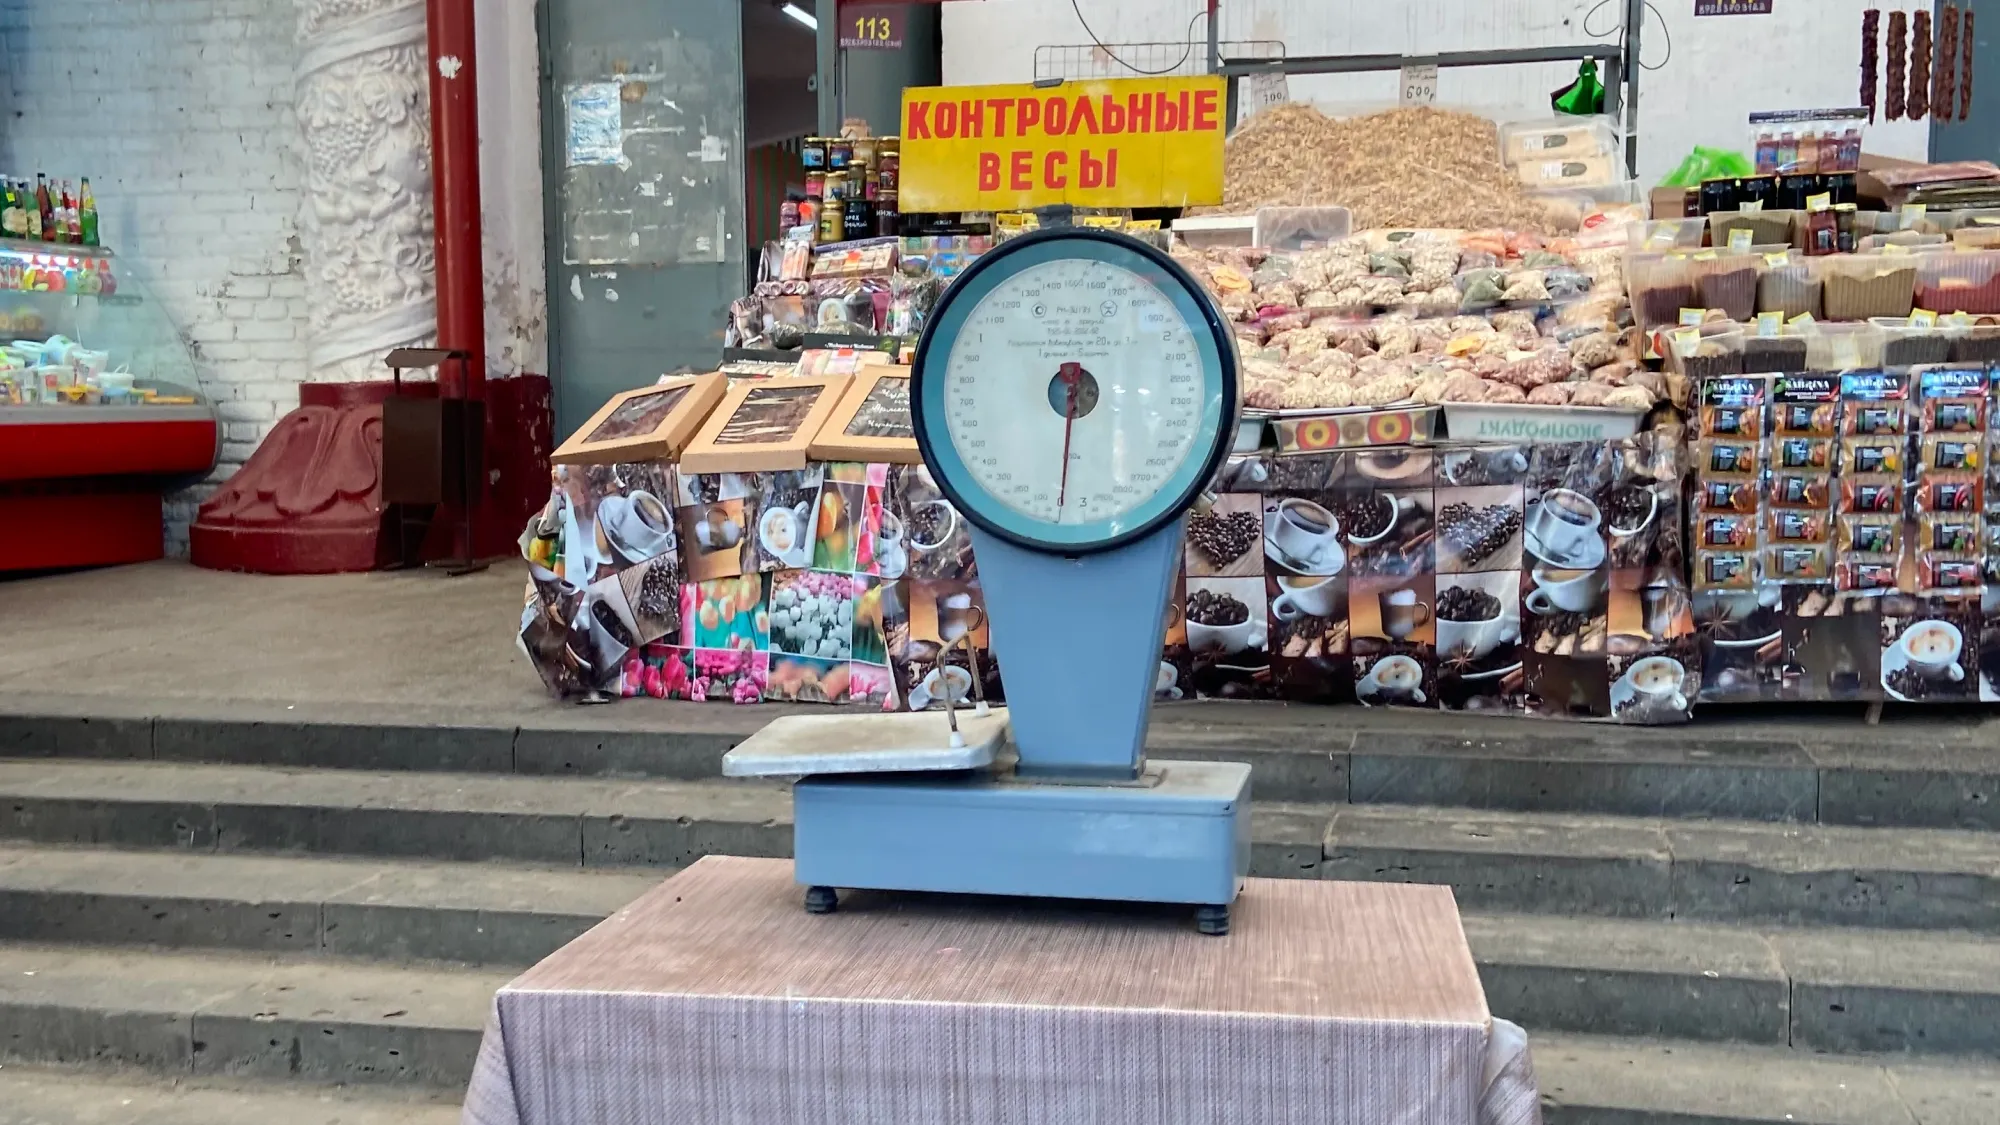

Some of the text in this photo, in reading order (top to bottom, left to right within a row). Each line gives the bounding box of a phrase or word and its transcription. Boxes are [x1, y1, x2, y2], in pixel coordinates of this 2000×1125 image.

[855, 16, 890, 40] 113
[907, 89, 1218, 140] КОНТРОЛЬНЫЕ
[979, 148, 1117, 192] ВЕСЫ
[1002, 301, 1020, 309] 1200
[985, 316, 1004, 324] 1100
[1163, 331, 1171, 342] 2
[1165, 353, 1186, 361] 2100
[1170, 397, 1191, 405] 2300
[1166, 419, 1187, 427] 2400
[1478, 418, 1603, 440] ЭКОПРОДУКТ
[996, 473, 1011, 481] 300
[1079, 497, 1087, 507] 3
